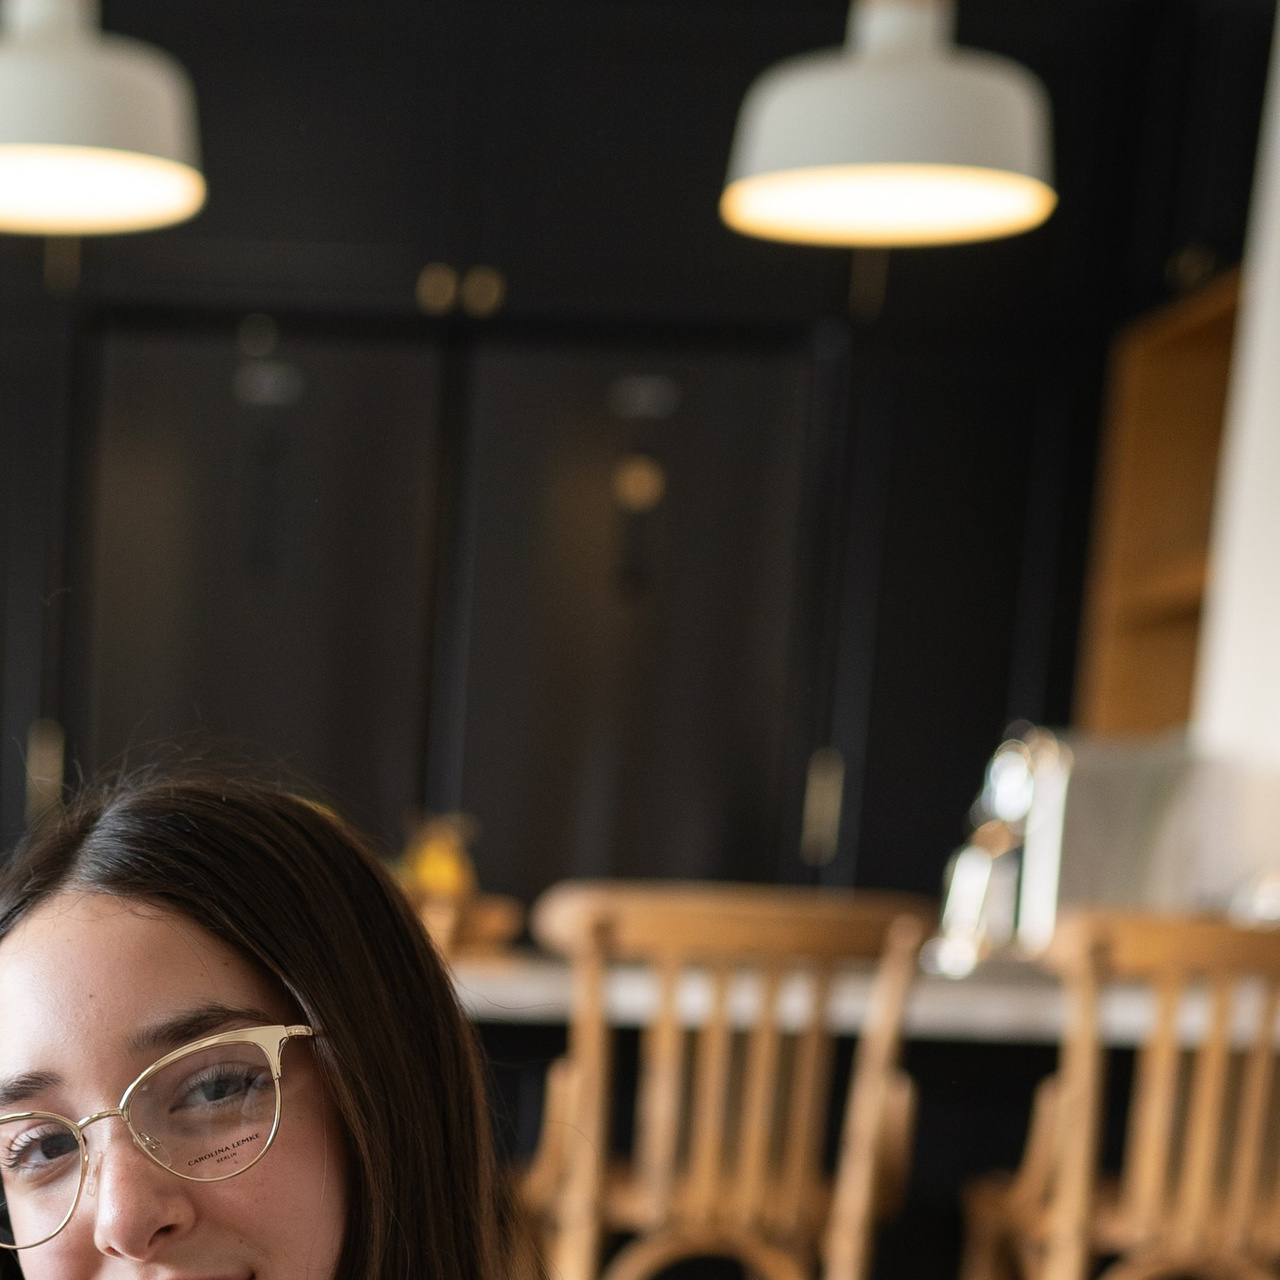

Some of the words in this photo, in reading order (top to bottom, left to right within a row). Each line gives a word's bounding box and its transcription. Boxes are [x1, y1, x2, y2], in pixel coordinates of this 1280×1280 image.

[187, 1146, 230, 1167] CAROLINA
[232, 1133, 261, 1149] LEMKE
[216, 1152, 237, 1163] BERLIN
